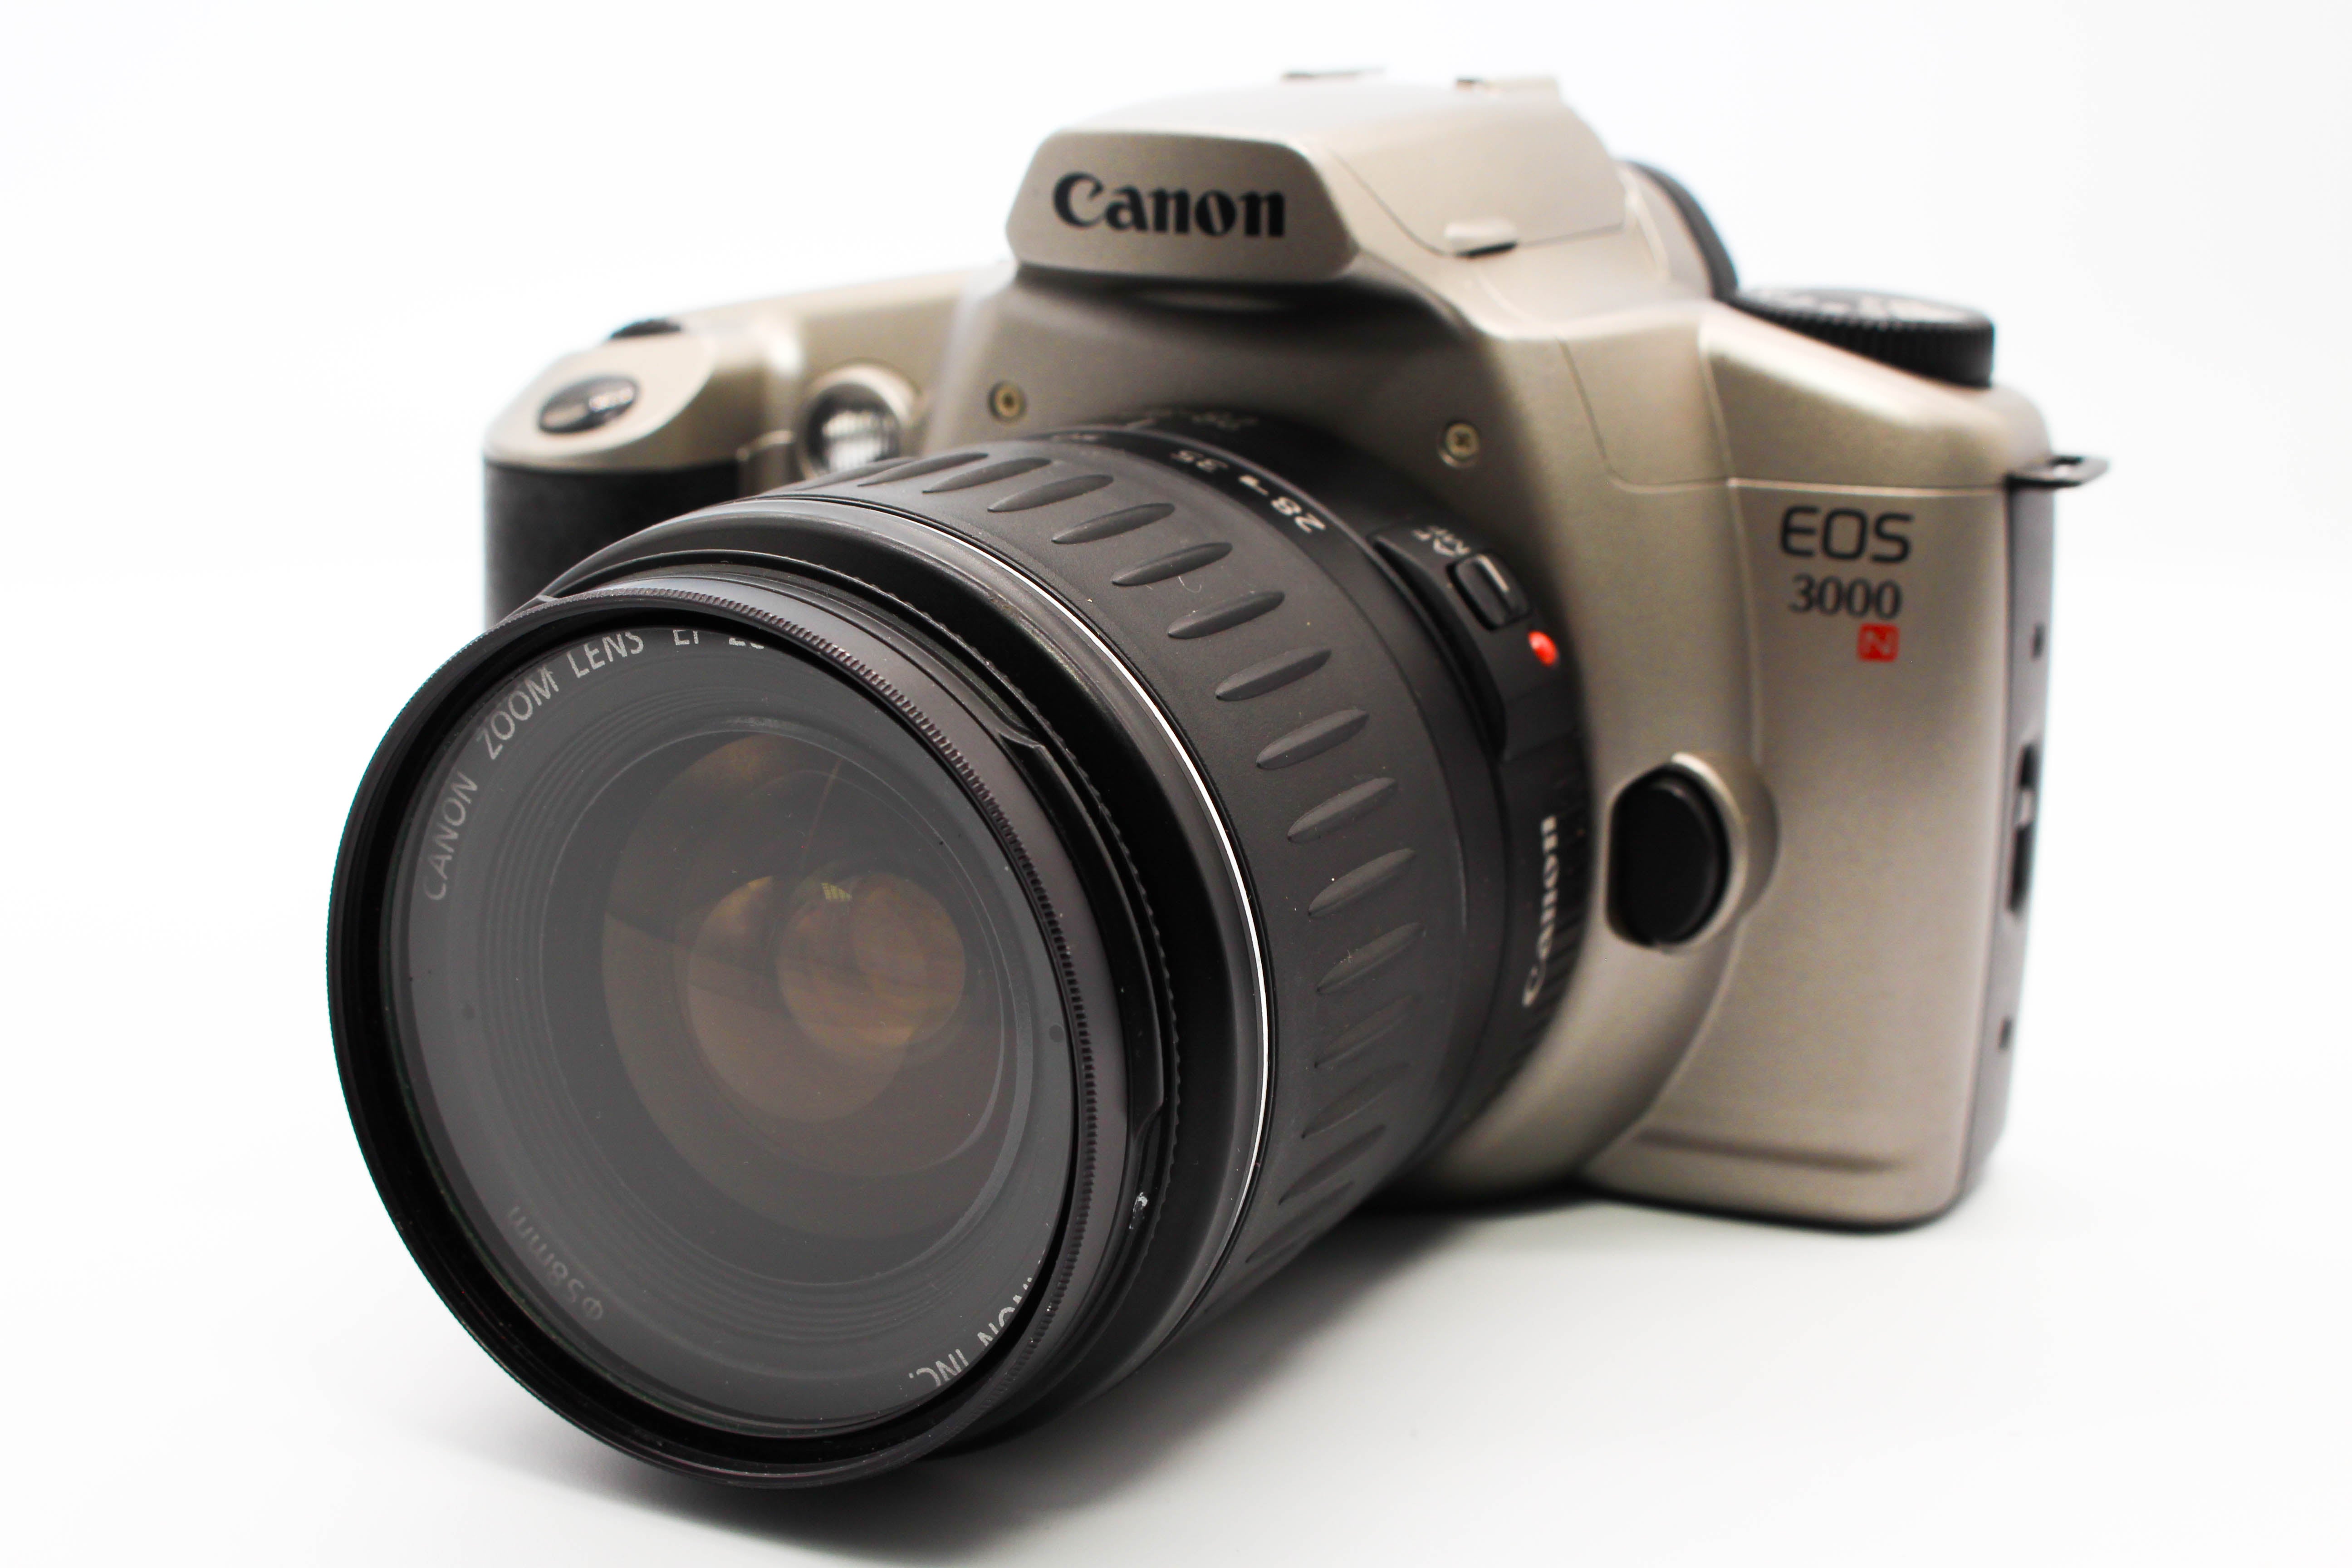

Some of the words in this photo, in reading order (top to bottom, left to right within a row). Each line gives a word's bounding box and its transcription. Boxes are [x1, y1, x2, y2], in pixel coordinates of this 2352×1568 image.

[1053, 172, 1285, 237] Canon
[1271, 496, 1326, 534] 28
[1780, 505, 1914, 564] EOS
[1788, 573, 1902, 620] 3000
[1857, 624, 1900, 662] N
[423, 771, 478, 901] CANON
[477, 665, 559, 760] ZOOM
[567, 631, 644, 678] LENS
[1521, 815, 1558, 1007] Canon
[908, 1348, 969, 1387] INC.
